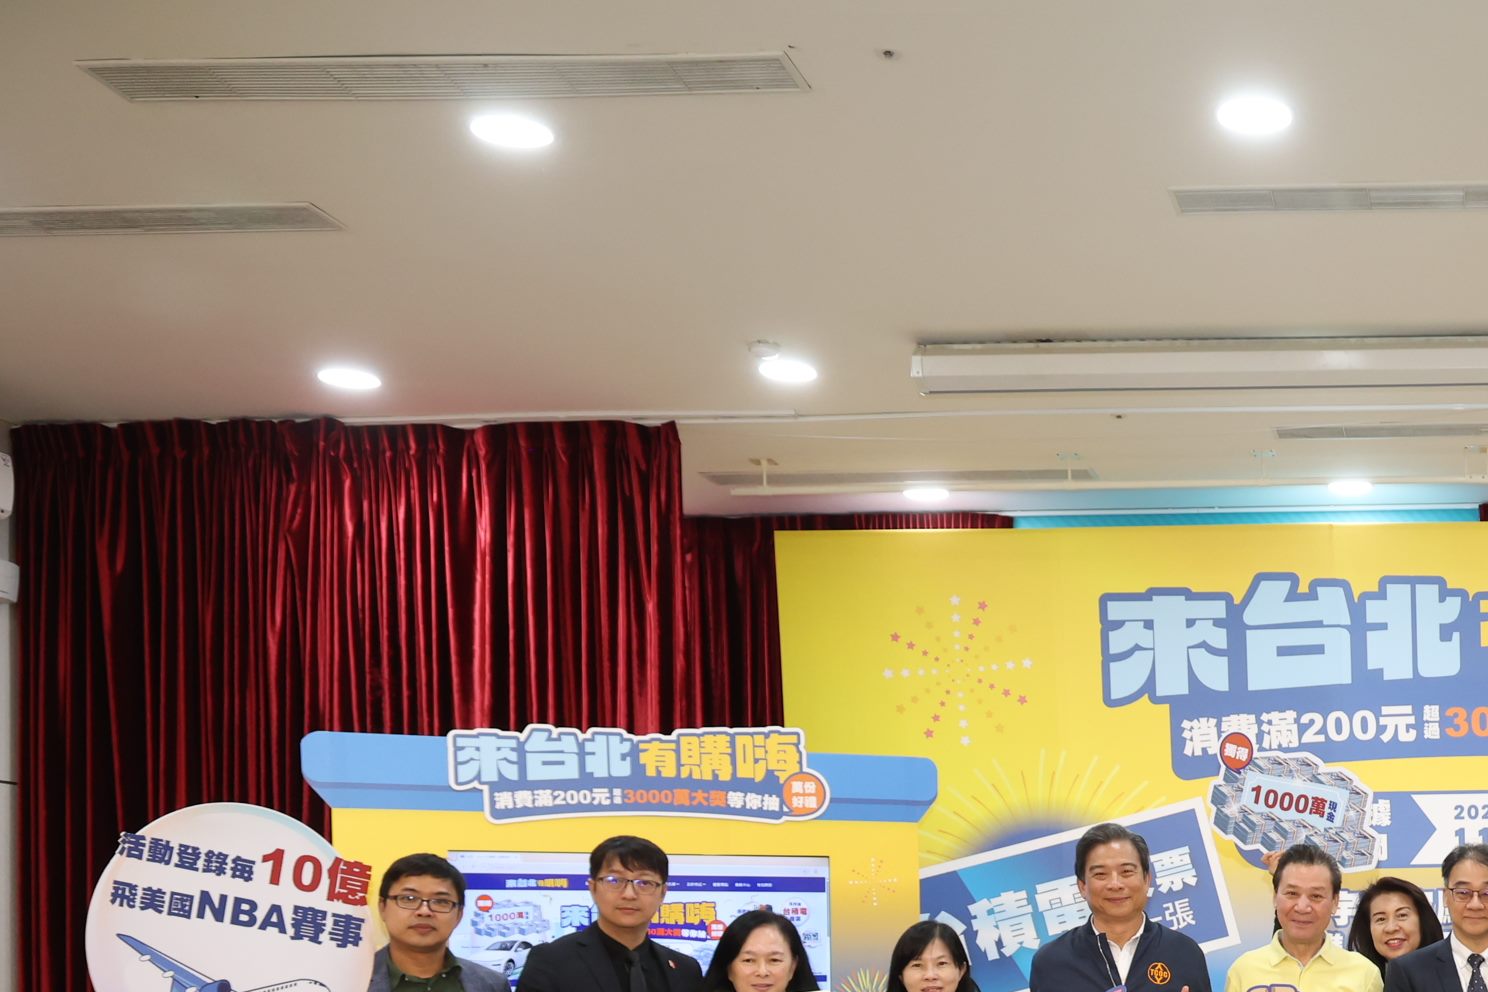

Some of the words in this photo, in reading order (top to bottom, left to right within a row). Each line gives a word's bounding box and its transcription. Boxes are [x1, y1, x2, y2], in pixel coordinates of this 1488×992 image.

[1223, 742, 1249, 762] 獨得
[1251, 785, 1328, 818] 1000萬
[110, 880, 366, 951] 飛美國NBA賽事
